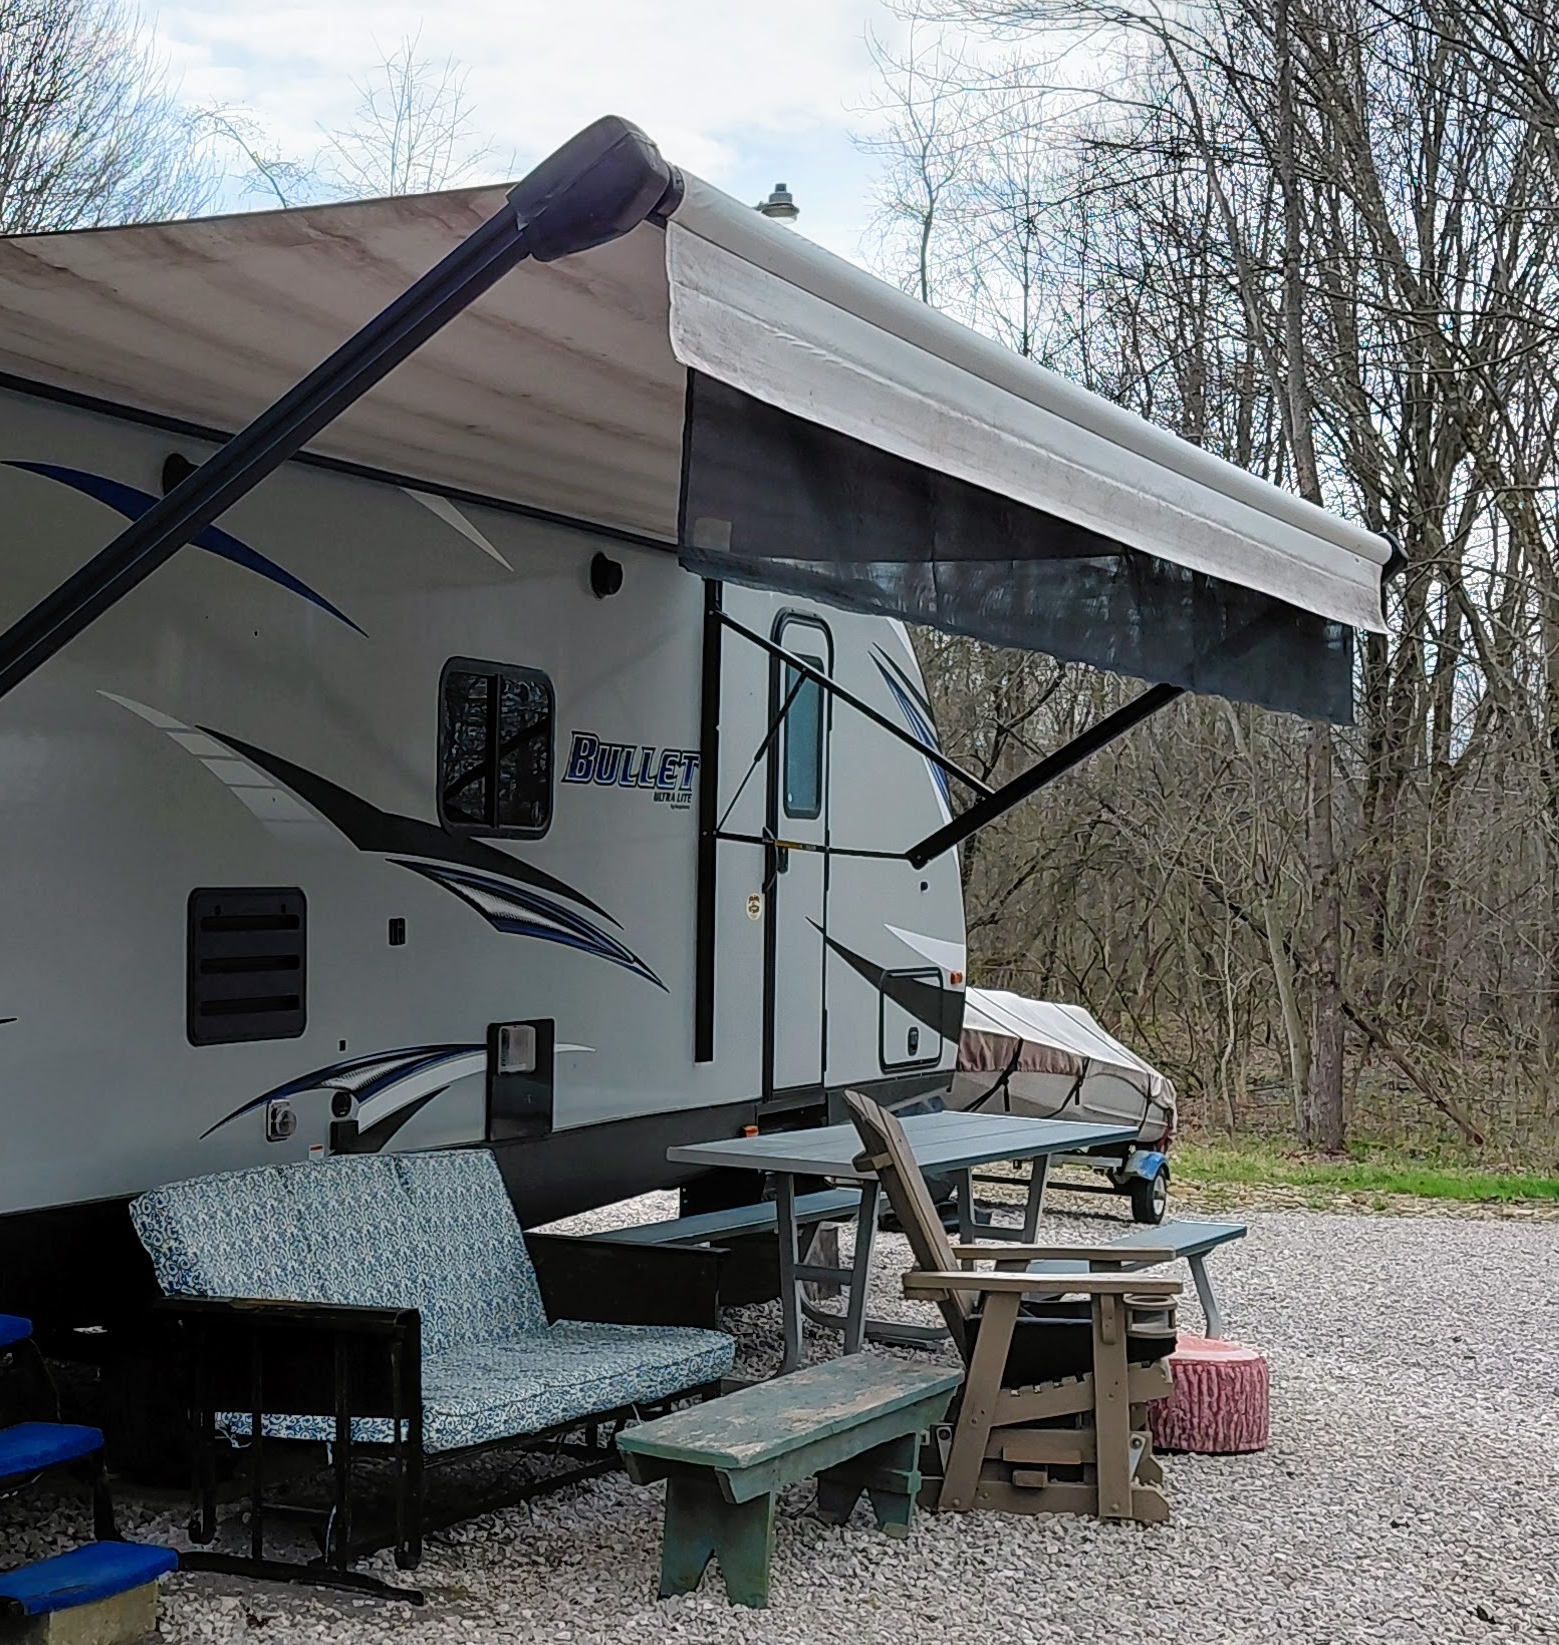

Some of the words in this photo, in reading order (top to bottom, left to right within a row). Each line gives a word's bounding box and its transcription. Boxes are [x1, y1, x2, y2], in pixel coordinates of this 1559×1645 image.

[561, 730, 701, 791] BULLET
[653, 791, 675, 803] ULTRA
[676, 793, 692, 804] LITE
